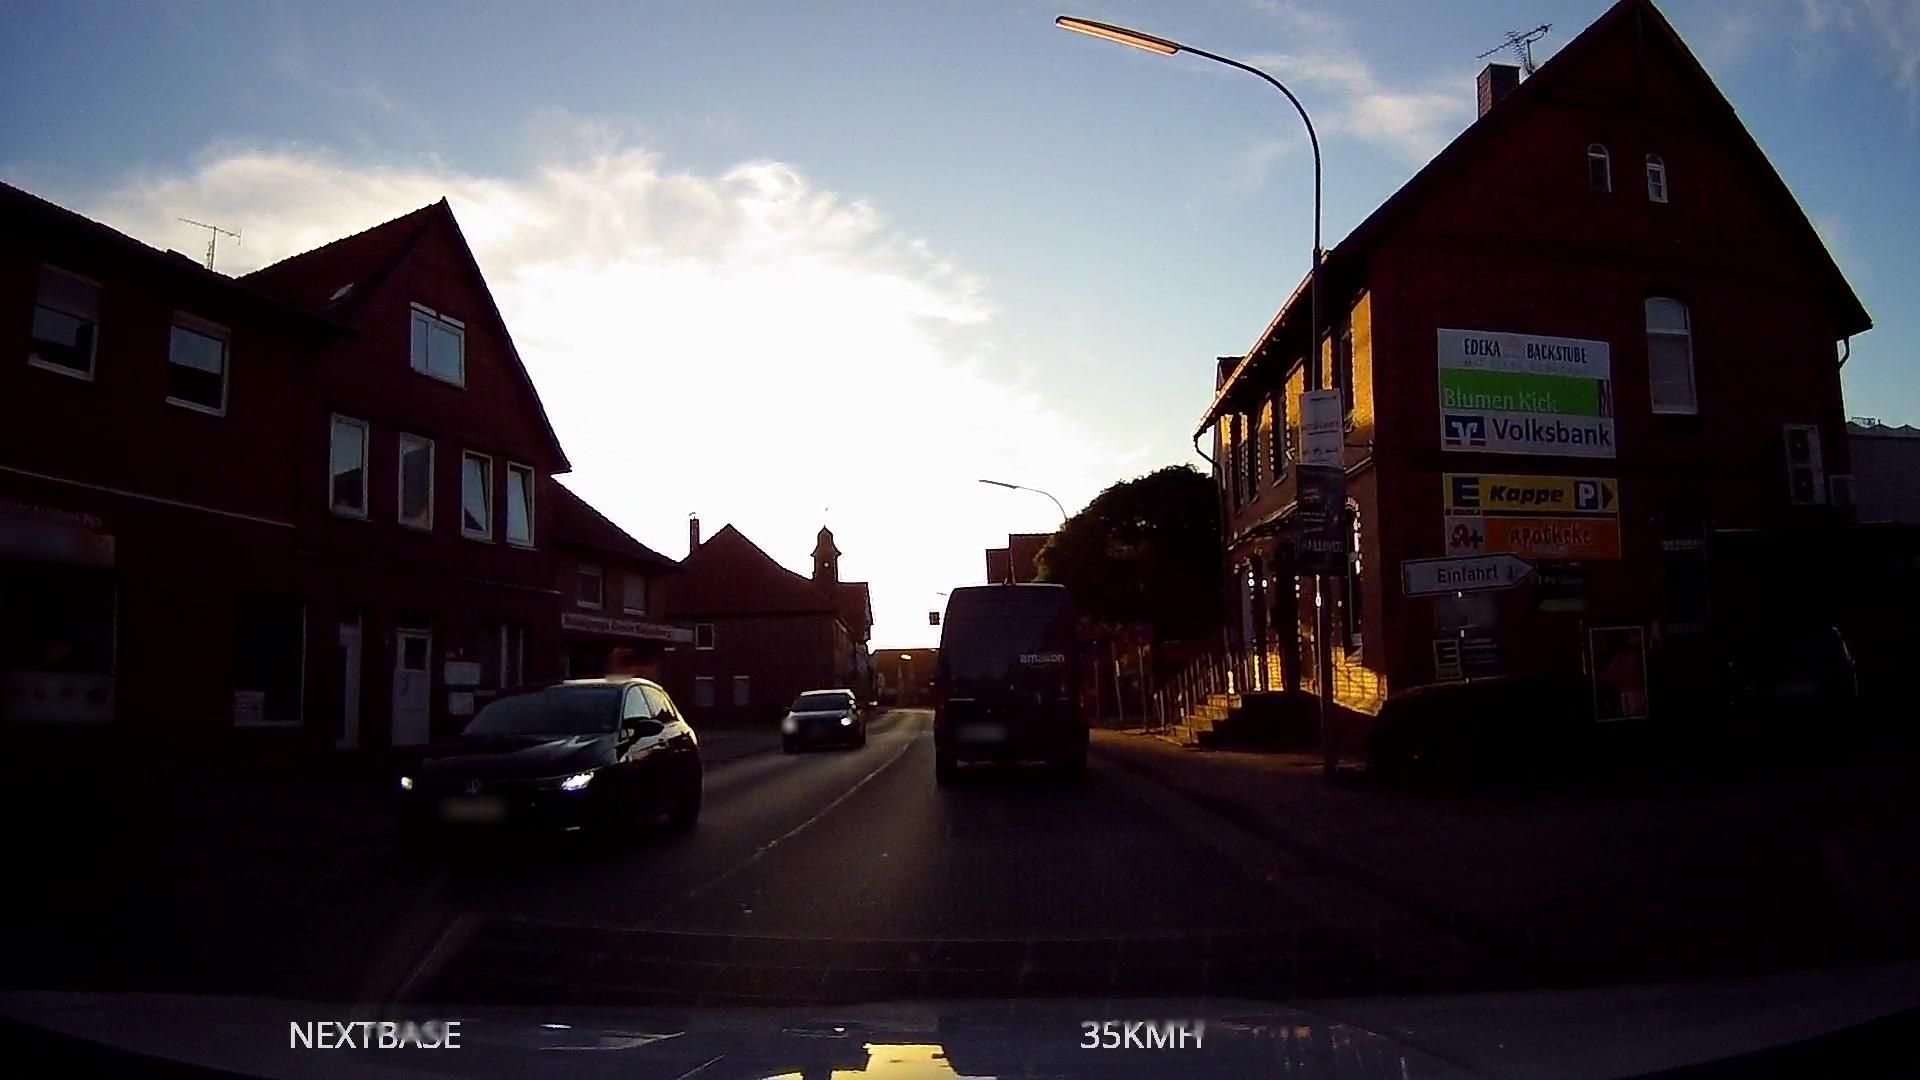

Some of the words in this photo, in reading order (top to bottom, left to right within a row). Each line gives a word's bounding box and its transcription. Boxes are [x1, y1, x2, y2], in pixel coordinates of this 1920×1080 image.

[1464, 338, 1501, 357] EDEKA
[1527, 343, 1587, 364] BACKSTUBE
[1443, 387, 1514, 410] Blumen
[1519, 391, 1559, 413] Kick
[1492, 418, 1611, 446] Volksbank
[1489, 485, 1564, 505] Kappe
[1578, 483, 1596, 508] P
[1509, 522, 1591, 551] apotheke
[1437, 563, 1498, 584] Einfahrt
